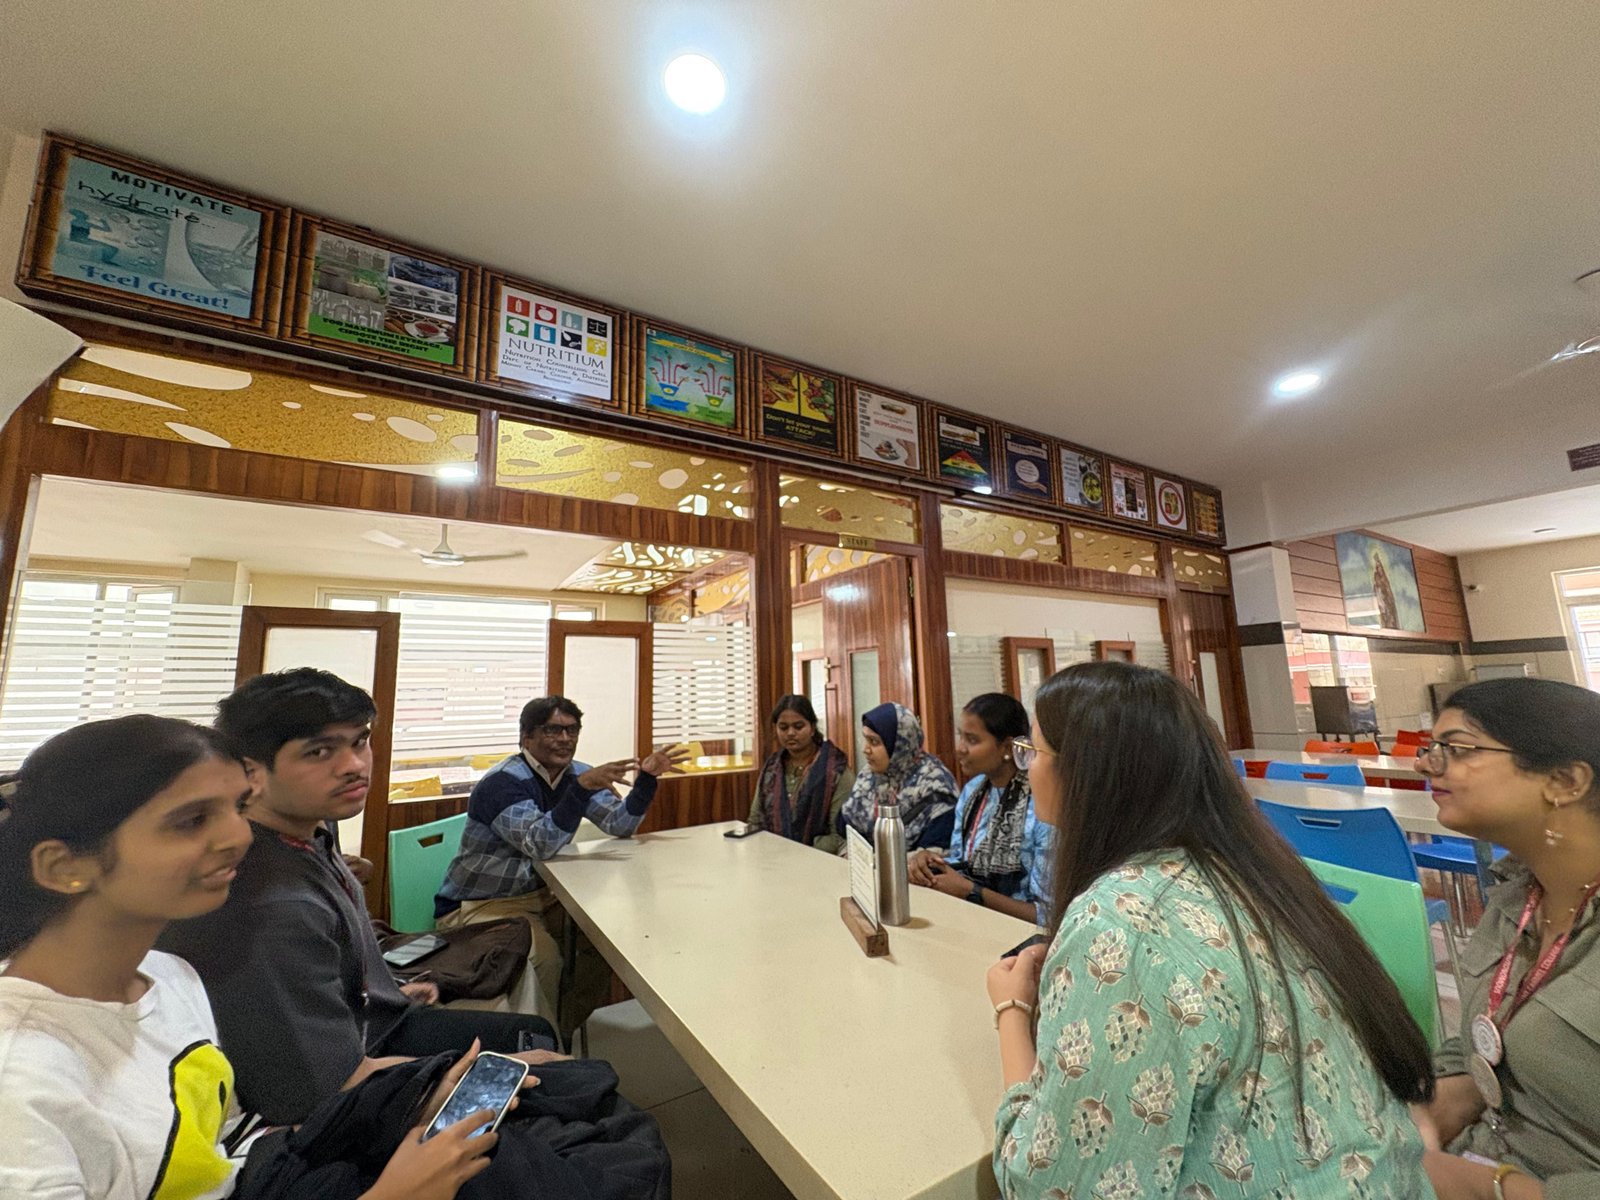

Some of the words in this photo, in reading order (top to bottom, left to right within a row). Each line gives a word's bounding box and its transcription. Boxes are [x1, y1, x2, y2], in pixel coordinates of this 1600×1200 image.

[111, 170, 235, 216] MOTIVATE
[79, 264, 140, 289] Feel
[148, 281, 229, 310] Great!
[508, 337, 604, 370] NUTRITIUM
[1543, 945, 1561, 970] COLLEGE
